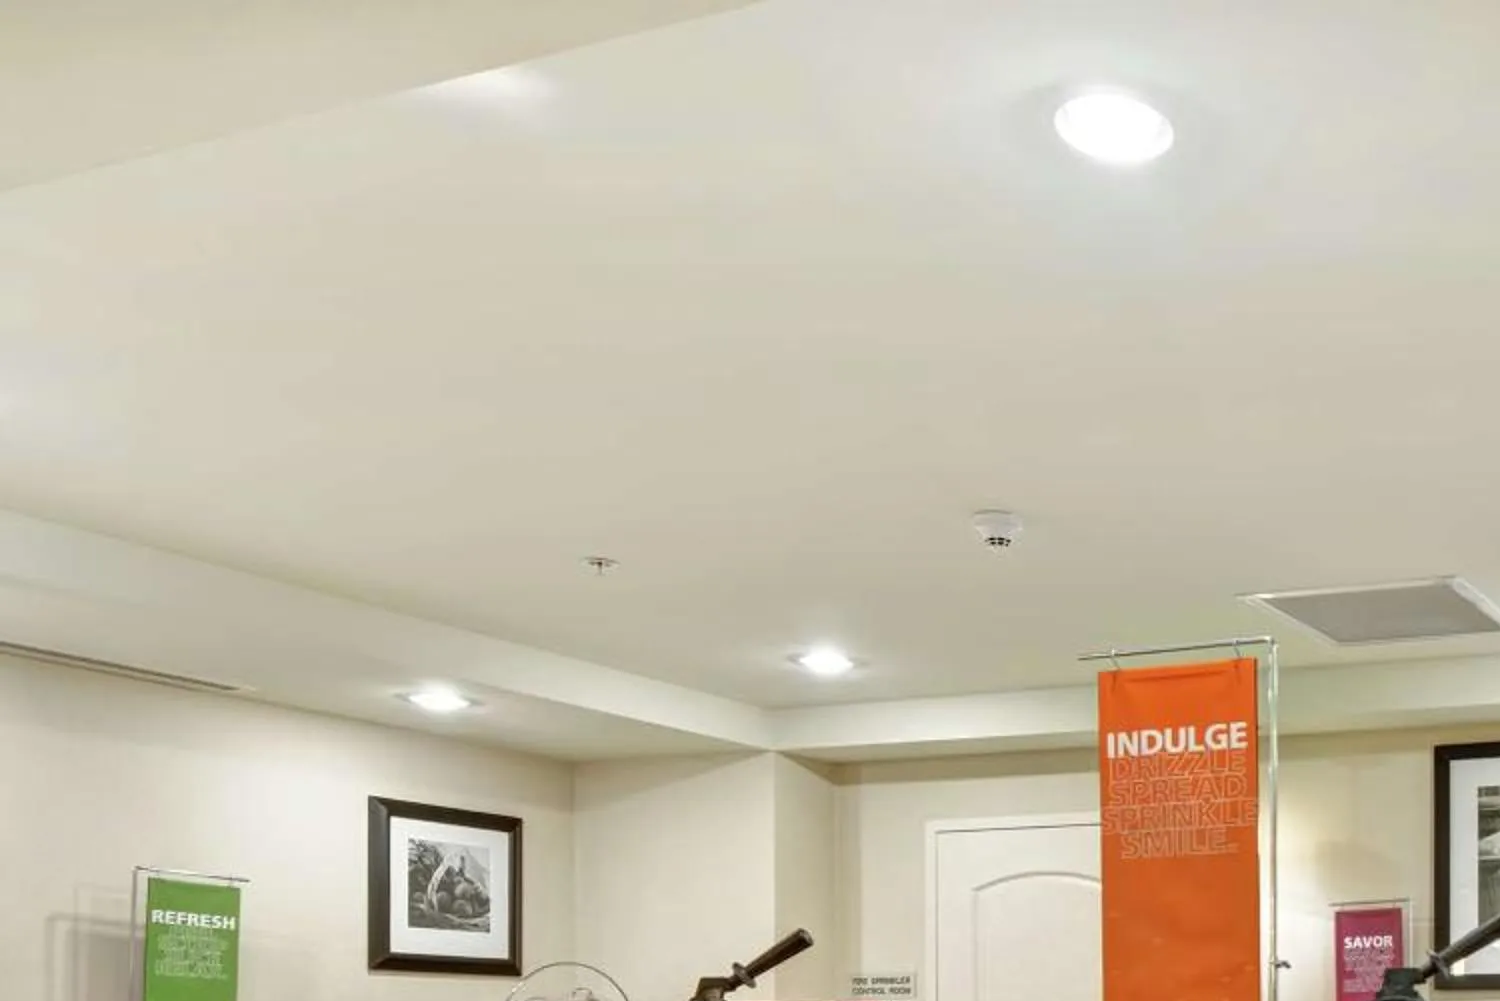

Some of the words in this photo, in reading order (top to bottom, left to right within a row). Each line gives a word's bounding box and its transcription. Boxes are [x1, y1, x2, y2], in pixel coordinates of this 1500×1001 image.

[1106, 721, 1249, 759] INDULGE
[1109, 751, 1247, 780] DRIZZLE
[1109, 773, 1247, 807] SPREAD
[1102, 799, 1257, 835] SPRINKLE
[152, 909, 236, 930] REFRESH
[1343, 934, 1394, 949] SAVOR
